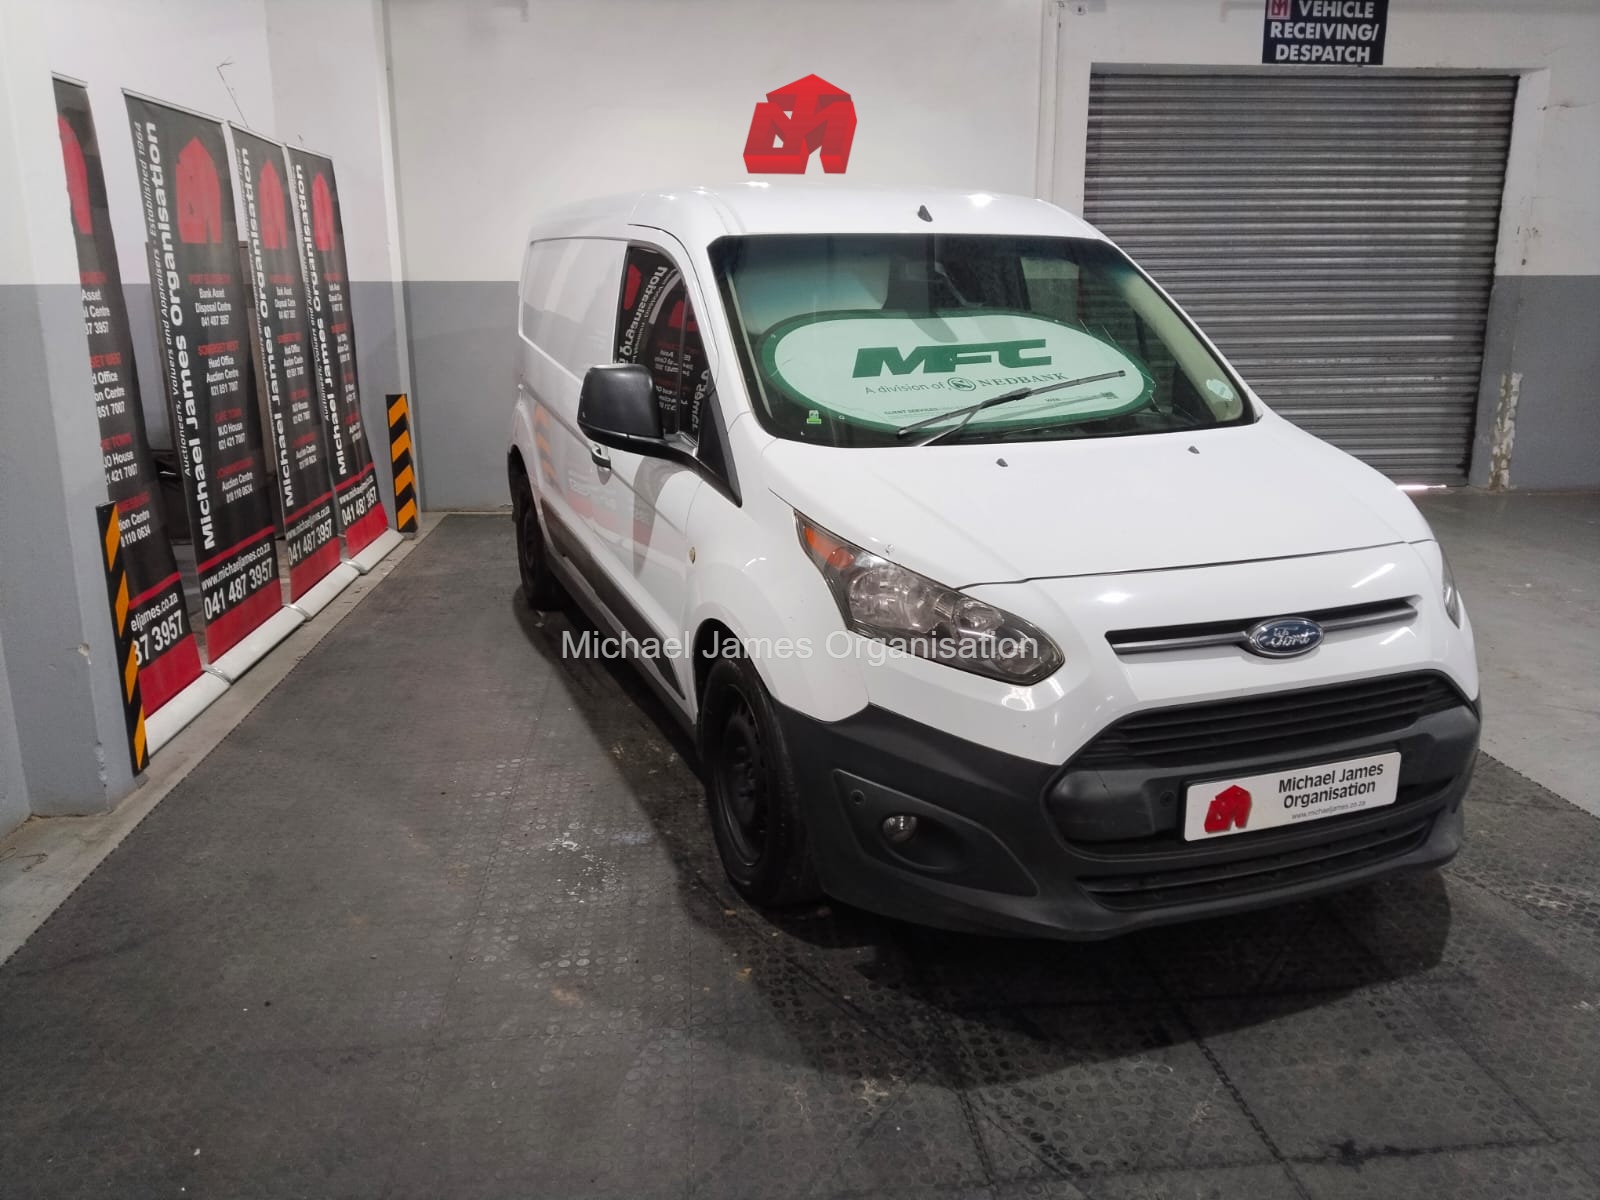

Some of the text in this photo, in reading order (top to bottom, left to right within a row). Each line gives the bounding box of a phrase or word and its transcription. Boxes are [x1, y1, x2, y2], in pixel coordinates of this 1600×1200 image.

[1299, 1, 1374, 18] VEHICLE
[1270, 22, 1379, 41] RECEIVING/
[1275, 44, 1370, 62] DESPATCH
[146, 122, 215, 550] Michael James Organisation
[317, 318, 333, 387] James
[264, 326, 280, 405] James
[851, 338, 1052, 379] MFC
[865, 372, 1069, 396] A division of NEDBANK
[326, 393, 347, 475] Michael
[112, 451, 134, 465] House
[274, 412, 294, 507] Michael
[342, 503, 355, 526] 041
[288, 518, 332, 566] 041 487 3957
[204, 557, 273, 620] 041 487 3957
[152, 609, 183, 651] 3957
[1266, 626, 1316, 648] Ford
[1278, 763, 1384, 793] Michael James
[1283, 780, 1376, 809] Organisation
